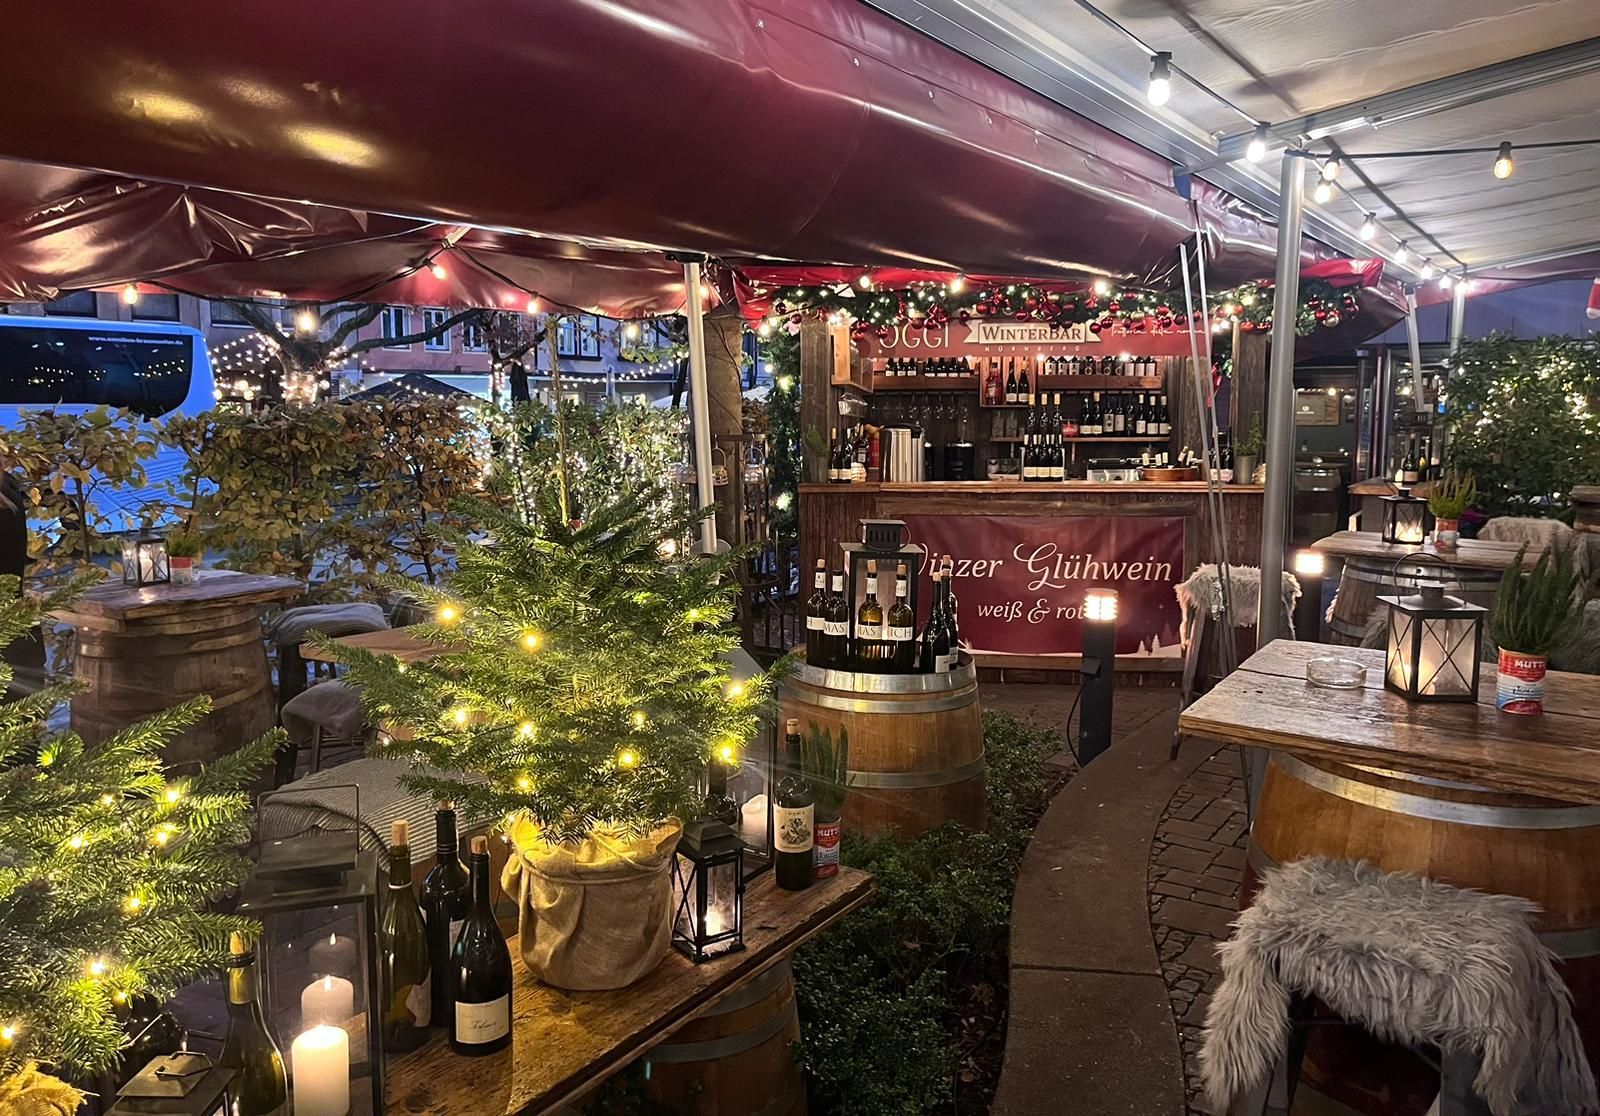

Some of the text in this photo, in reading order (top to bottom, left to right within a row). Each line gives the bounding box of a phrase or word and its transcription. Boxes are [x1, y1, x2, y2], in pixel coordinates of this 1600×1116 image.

[879, 319, 949, 349] OGGI
[918, 542, 1173, 591] inzer Glühwein
[977, 598, 1084, 624] weiß & rot
